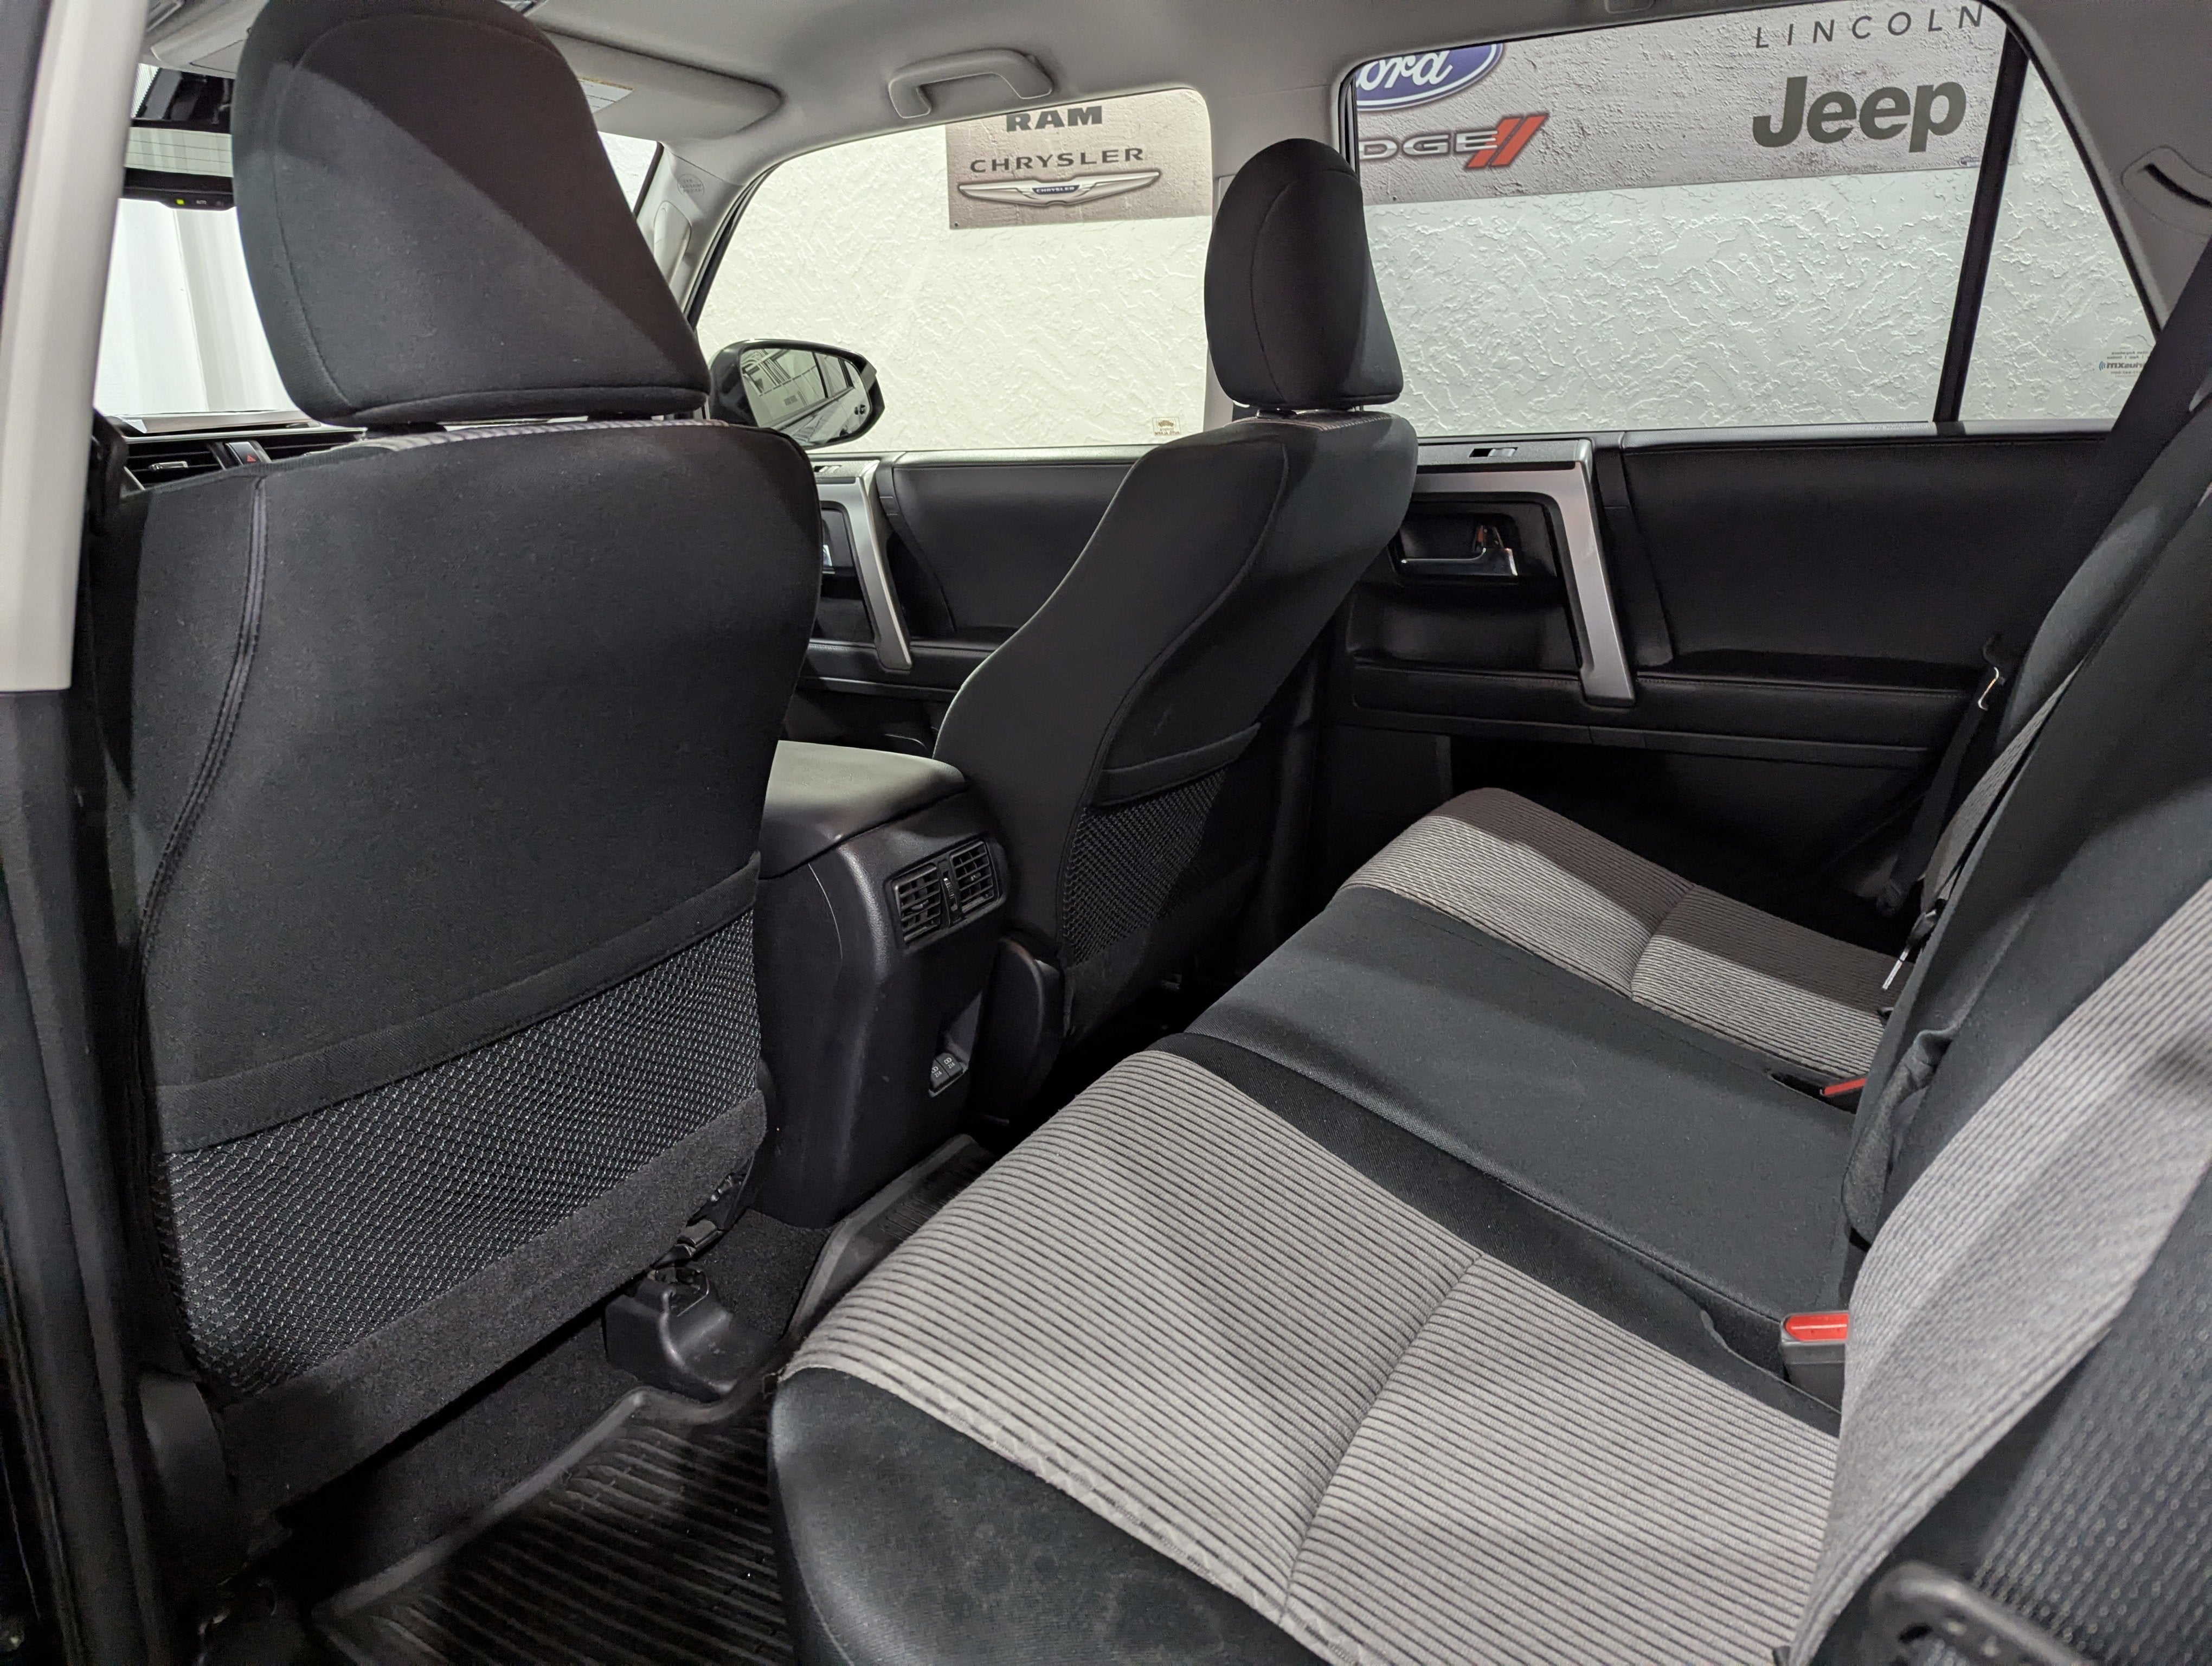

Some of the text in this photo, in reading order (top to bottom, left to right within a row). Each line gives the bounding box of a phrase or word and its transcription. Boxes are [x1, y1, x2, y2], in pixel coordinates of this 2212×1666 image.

[1756, 5, 1983, 48] LINCOLN
[1356, 50, 1454, 91] ord
[1006, 105, 1102, 132] RAM
[1752, 75, 1967, 152] Jeep
[970, 148, 1143, 172] CHRYSLER
[1359, 130, 1498, 160] DGE
